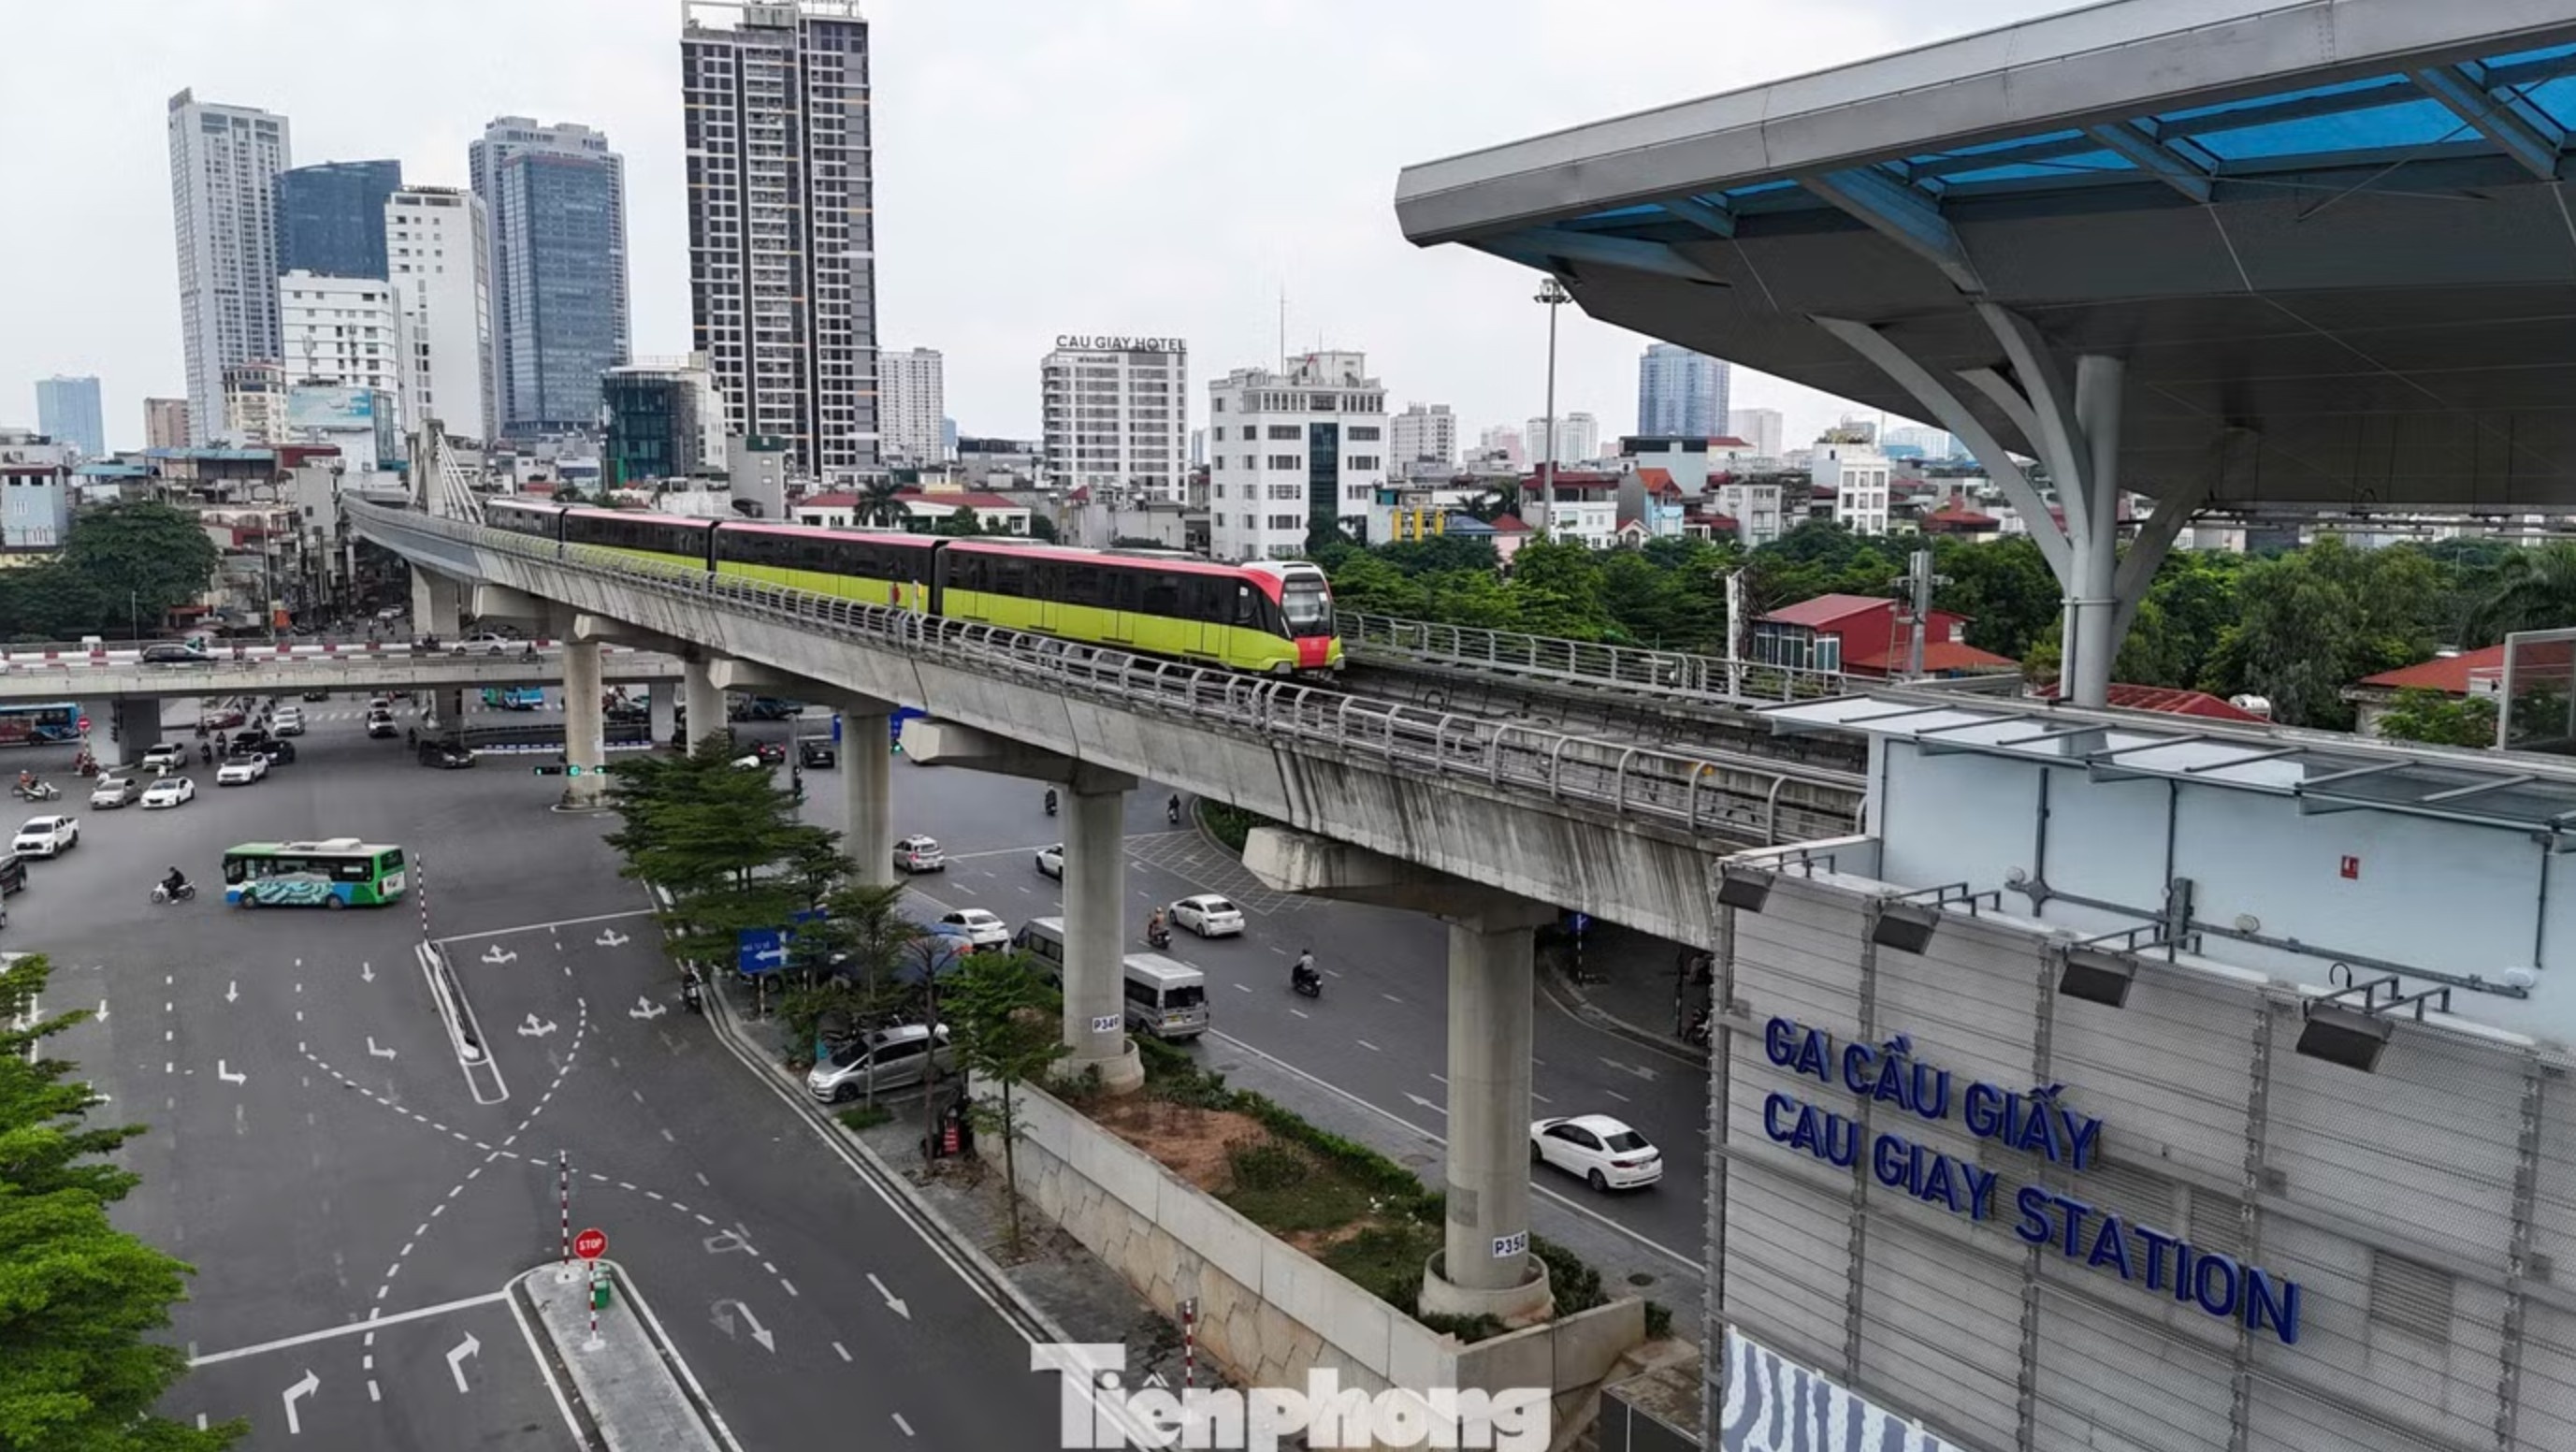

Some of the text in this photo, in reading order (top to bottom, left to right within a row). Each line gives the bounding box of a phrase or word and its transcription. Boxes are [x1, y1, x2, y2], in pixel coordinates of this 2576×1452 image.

[1056, 335, 1187, 351] CAU GIAY HOTEL
[1765, 1016, 2103, 1169] GA CẦU GIẤY
[579, 1238, 603, 1251] STOP
[1763, 1092, 2301, 1345] CAU GIAY STATION
